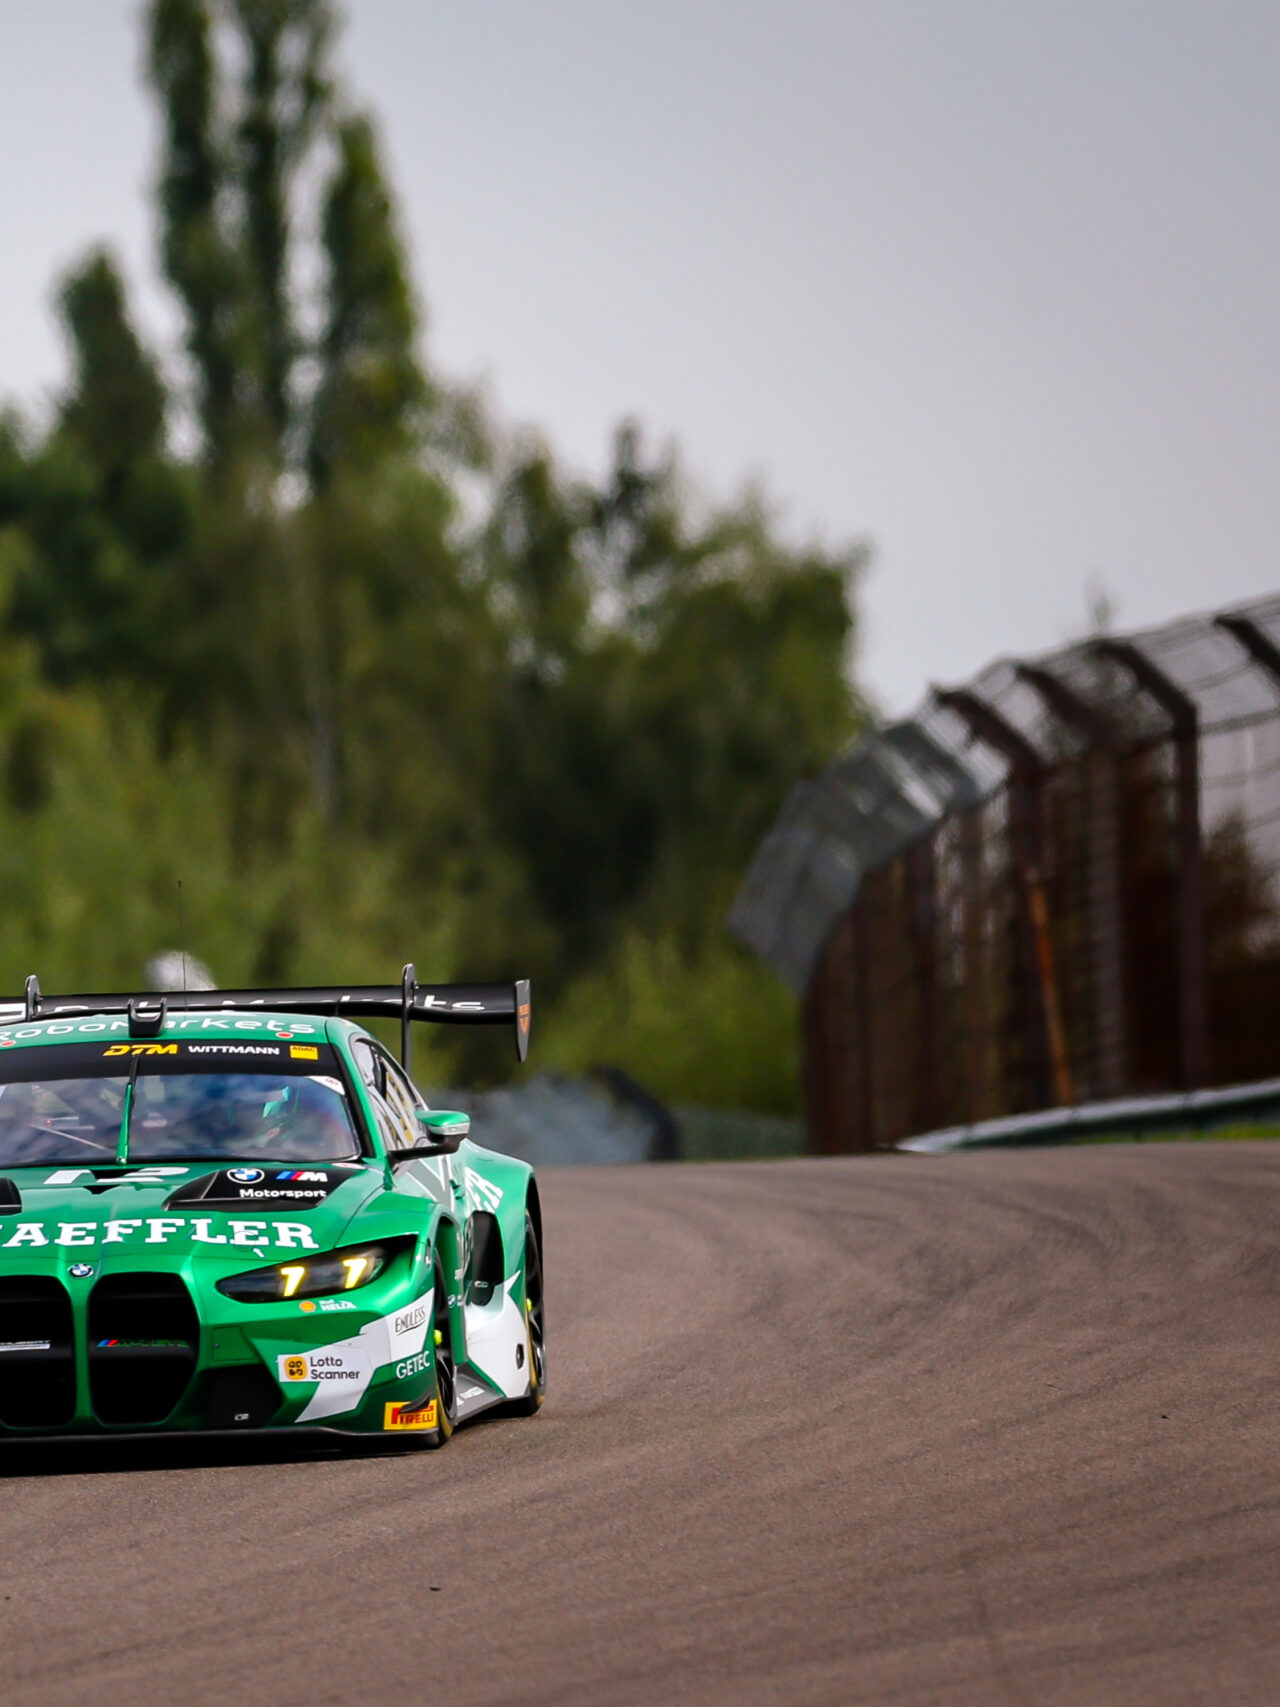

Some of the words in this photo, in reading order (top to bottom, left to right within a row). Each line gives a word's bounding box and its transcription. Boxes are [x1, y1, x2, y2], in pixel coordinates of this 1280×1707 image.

[103, 1044, 179, 1057] DTM
[188, 1045, 280, 1055] WITTMANN
[239, 1188, 327, 1199] Motorsport
[394, 1305, 425, 1333] ENDLESS
[310, 1356, 343, 1367] Lotto
[395, 1350, 431, 1379] GETEC
[311, 1369, 360, 1380] Scanner
